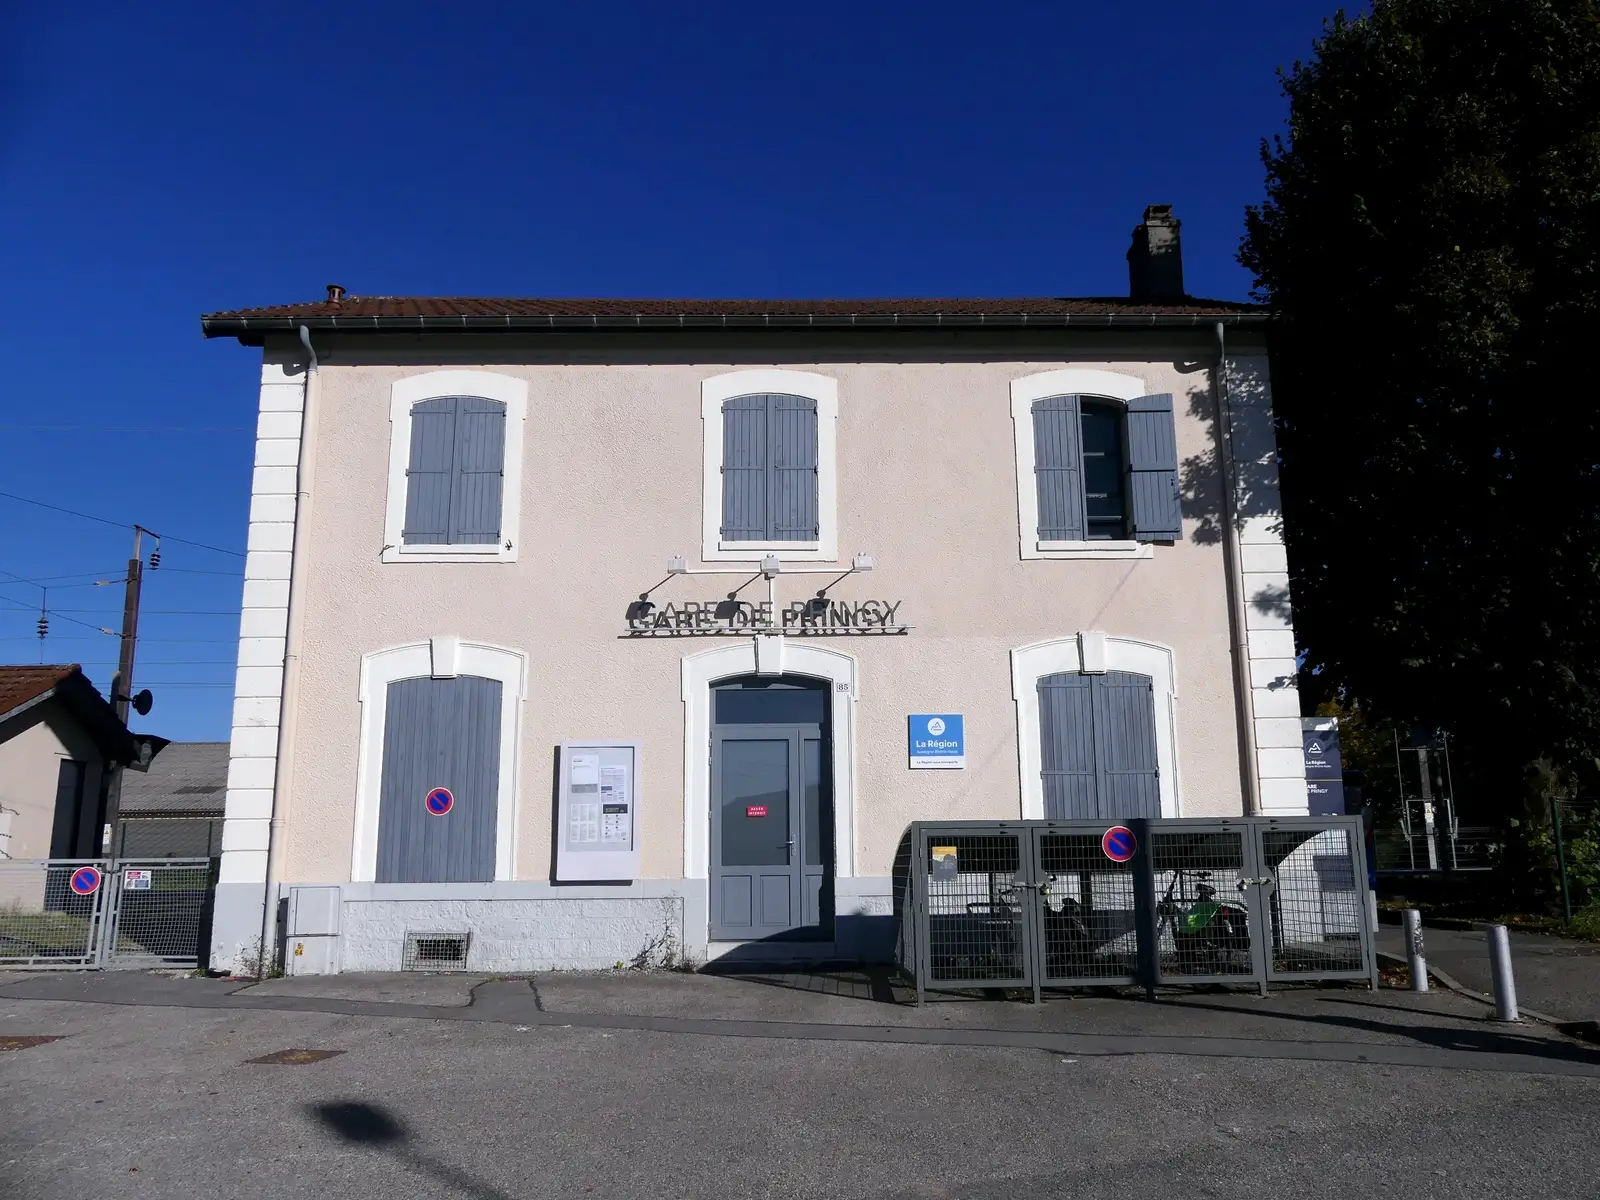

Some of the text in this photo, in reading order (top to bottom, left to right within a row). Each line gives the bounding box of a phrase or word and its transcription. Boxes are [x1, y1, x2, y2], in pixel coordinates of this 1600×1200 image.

[638, 600, 902, 626] GARE DE PRINGY
[916, 740, 958, 749] La Région
